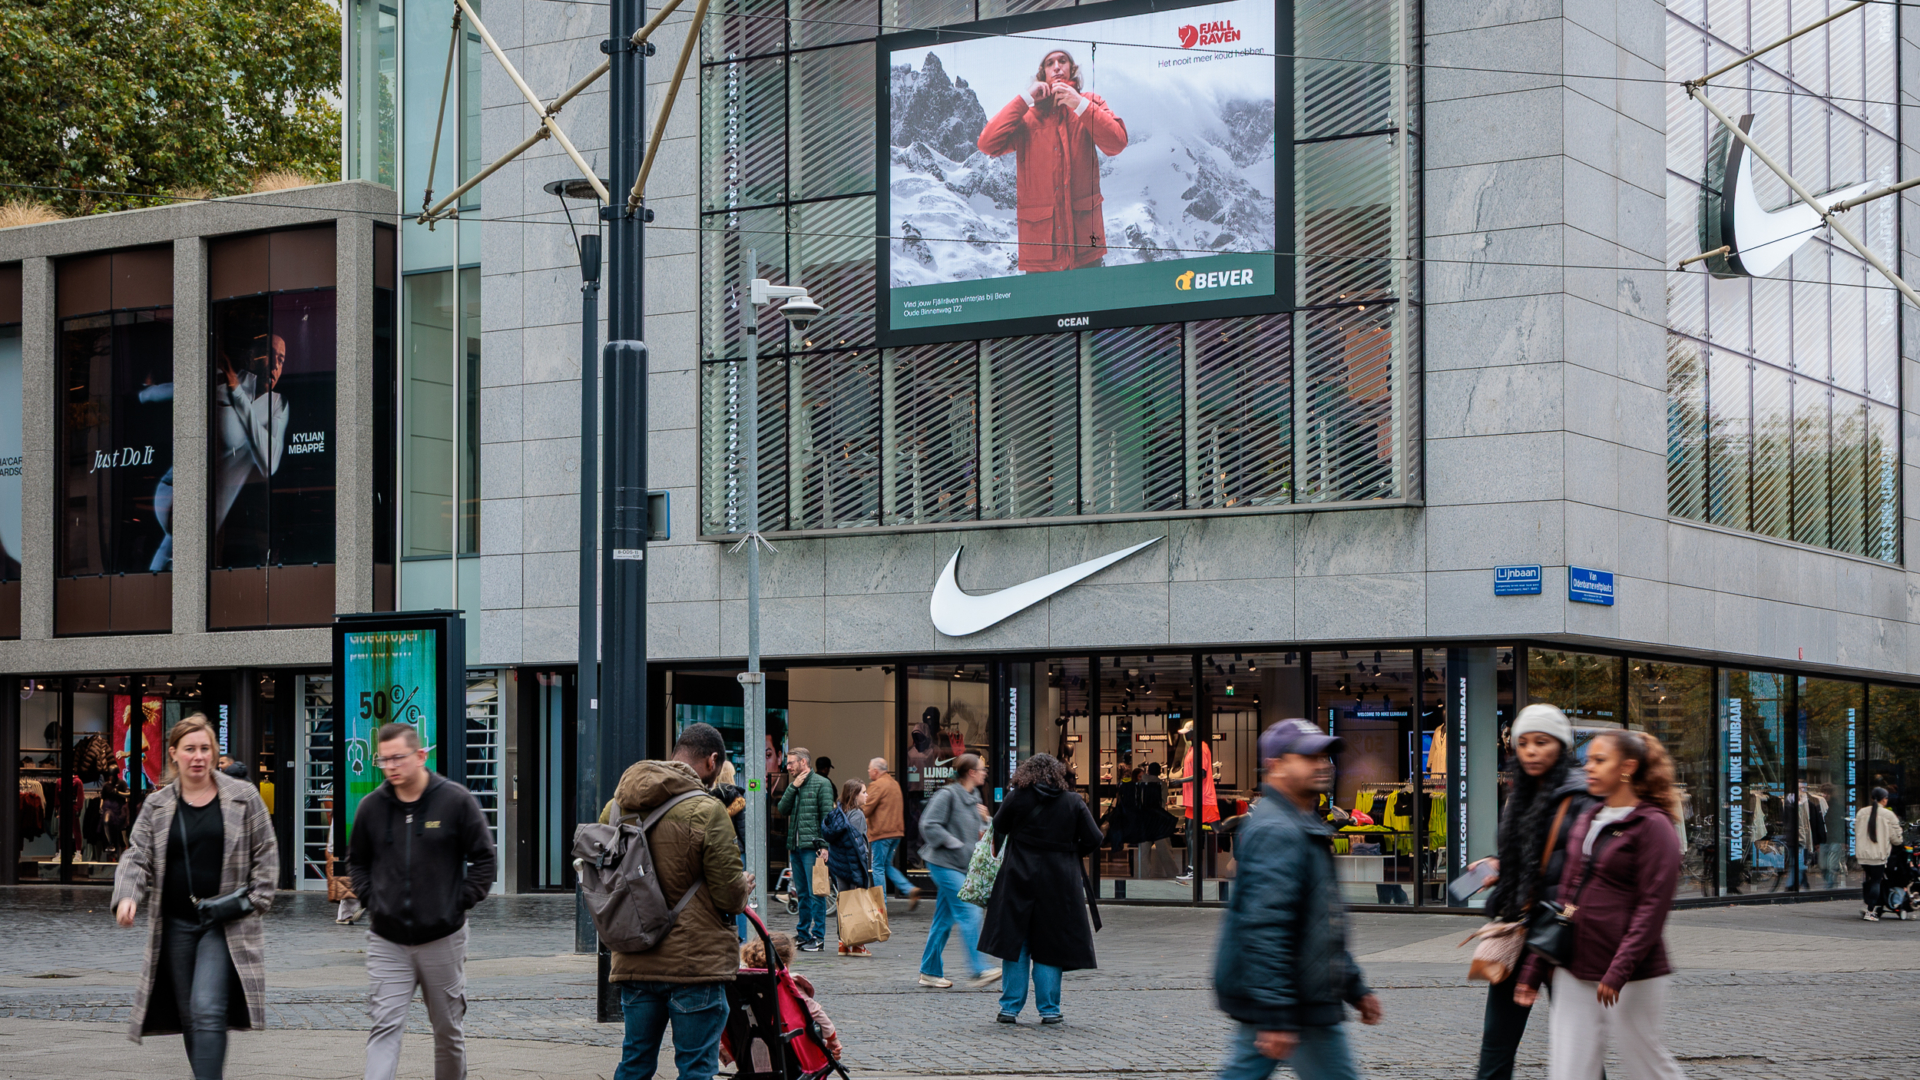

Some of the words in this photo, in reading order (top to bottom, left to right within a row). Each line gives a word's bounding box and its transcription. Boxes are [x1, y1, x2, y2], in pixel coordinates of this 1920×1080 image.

[1199, 19, 1234, 35] FJÄLL
[1158, 60, 1171, 68] Het
[1172, 56, 1192, 66] nooit
[1193, 53, 1213, 63] meer
[1214, 49, 1234, 60] koud
[1234, 47, 1265, 58] hebben
[1195, 268, 1254, 290] BEVER
[903, 309, 920, 317] Oude
[917, 300, 932, 308] jouw
[1057, 316, 1090, 328] OCEAN
[292, 431, 325, 443] KYLIAN
[288, 441, 325, 455] MBAPPÉ
[89, 449, 120, 474] Just
[120, 446, 141, 467] Do
[141, 445, 155, 465] It
[1498, 569, 1537, 580] Lijnbaan
[1588, 571, 1598, 581] Van
[1009, 687, 1017, 747] LIJNBAAN
[1459, 677, 1467, 742] LIJNBAAN
[219, 704, 228, 755] LIJNBAAN
[1730, 698, 1742, 753] LIJNBAAN
[923, 767, 955, 778] LIJNBA
[1730, 755, 1742, 783] NIKE
[1460, 780, 1467, 799] TO
[1730, 785, 1742, 802] TO
[1731, 804, 1743, 862] WELCOME
